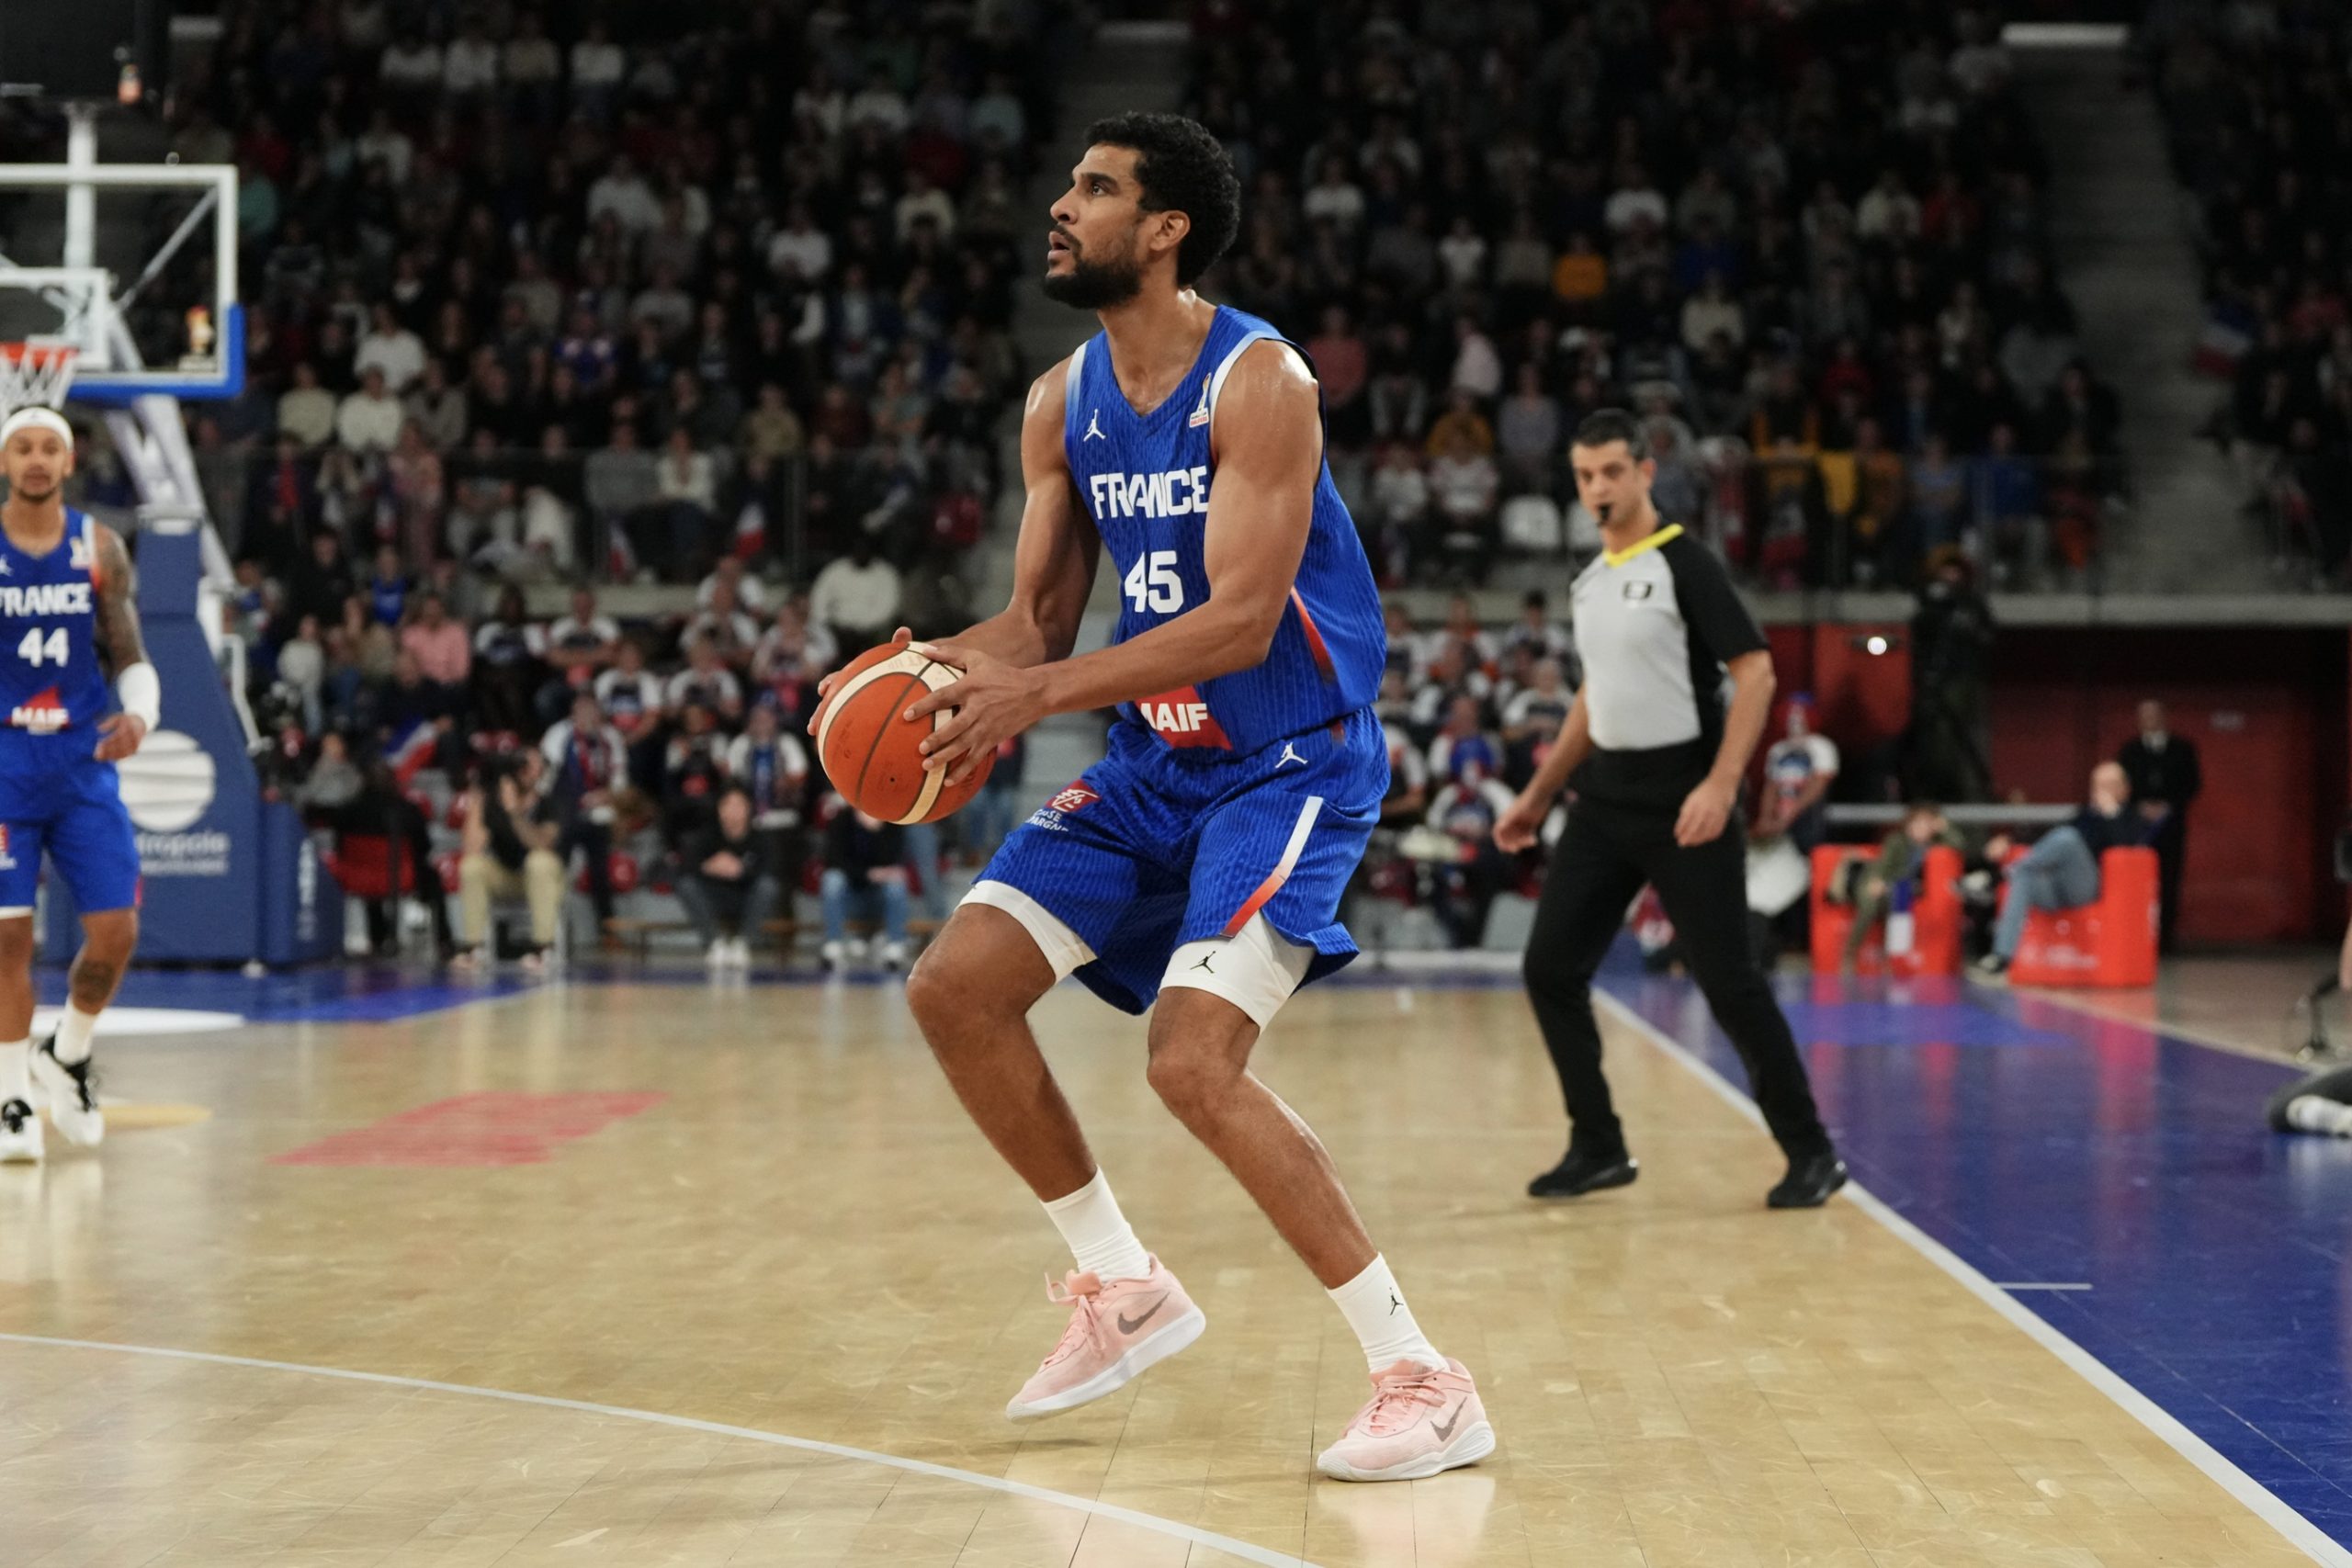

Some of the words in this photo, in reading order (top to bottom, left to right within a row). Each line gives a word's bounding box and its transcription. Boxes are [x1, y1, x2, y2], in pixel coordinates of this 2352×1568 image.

[1090, 465, 1209, 520] FRANCE
[0, 582, 93, 617] RANCE
[1124, 550, 1184, 614] 45
[17, 626, 70, 668] 44
